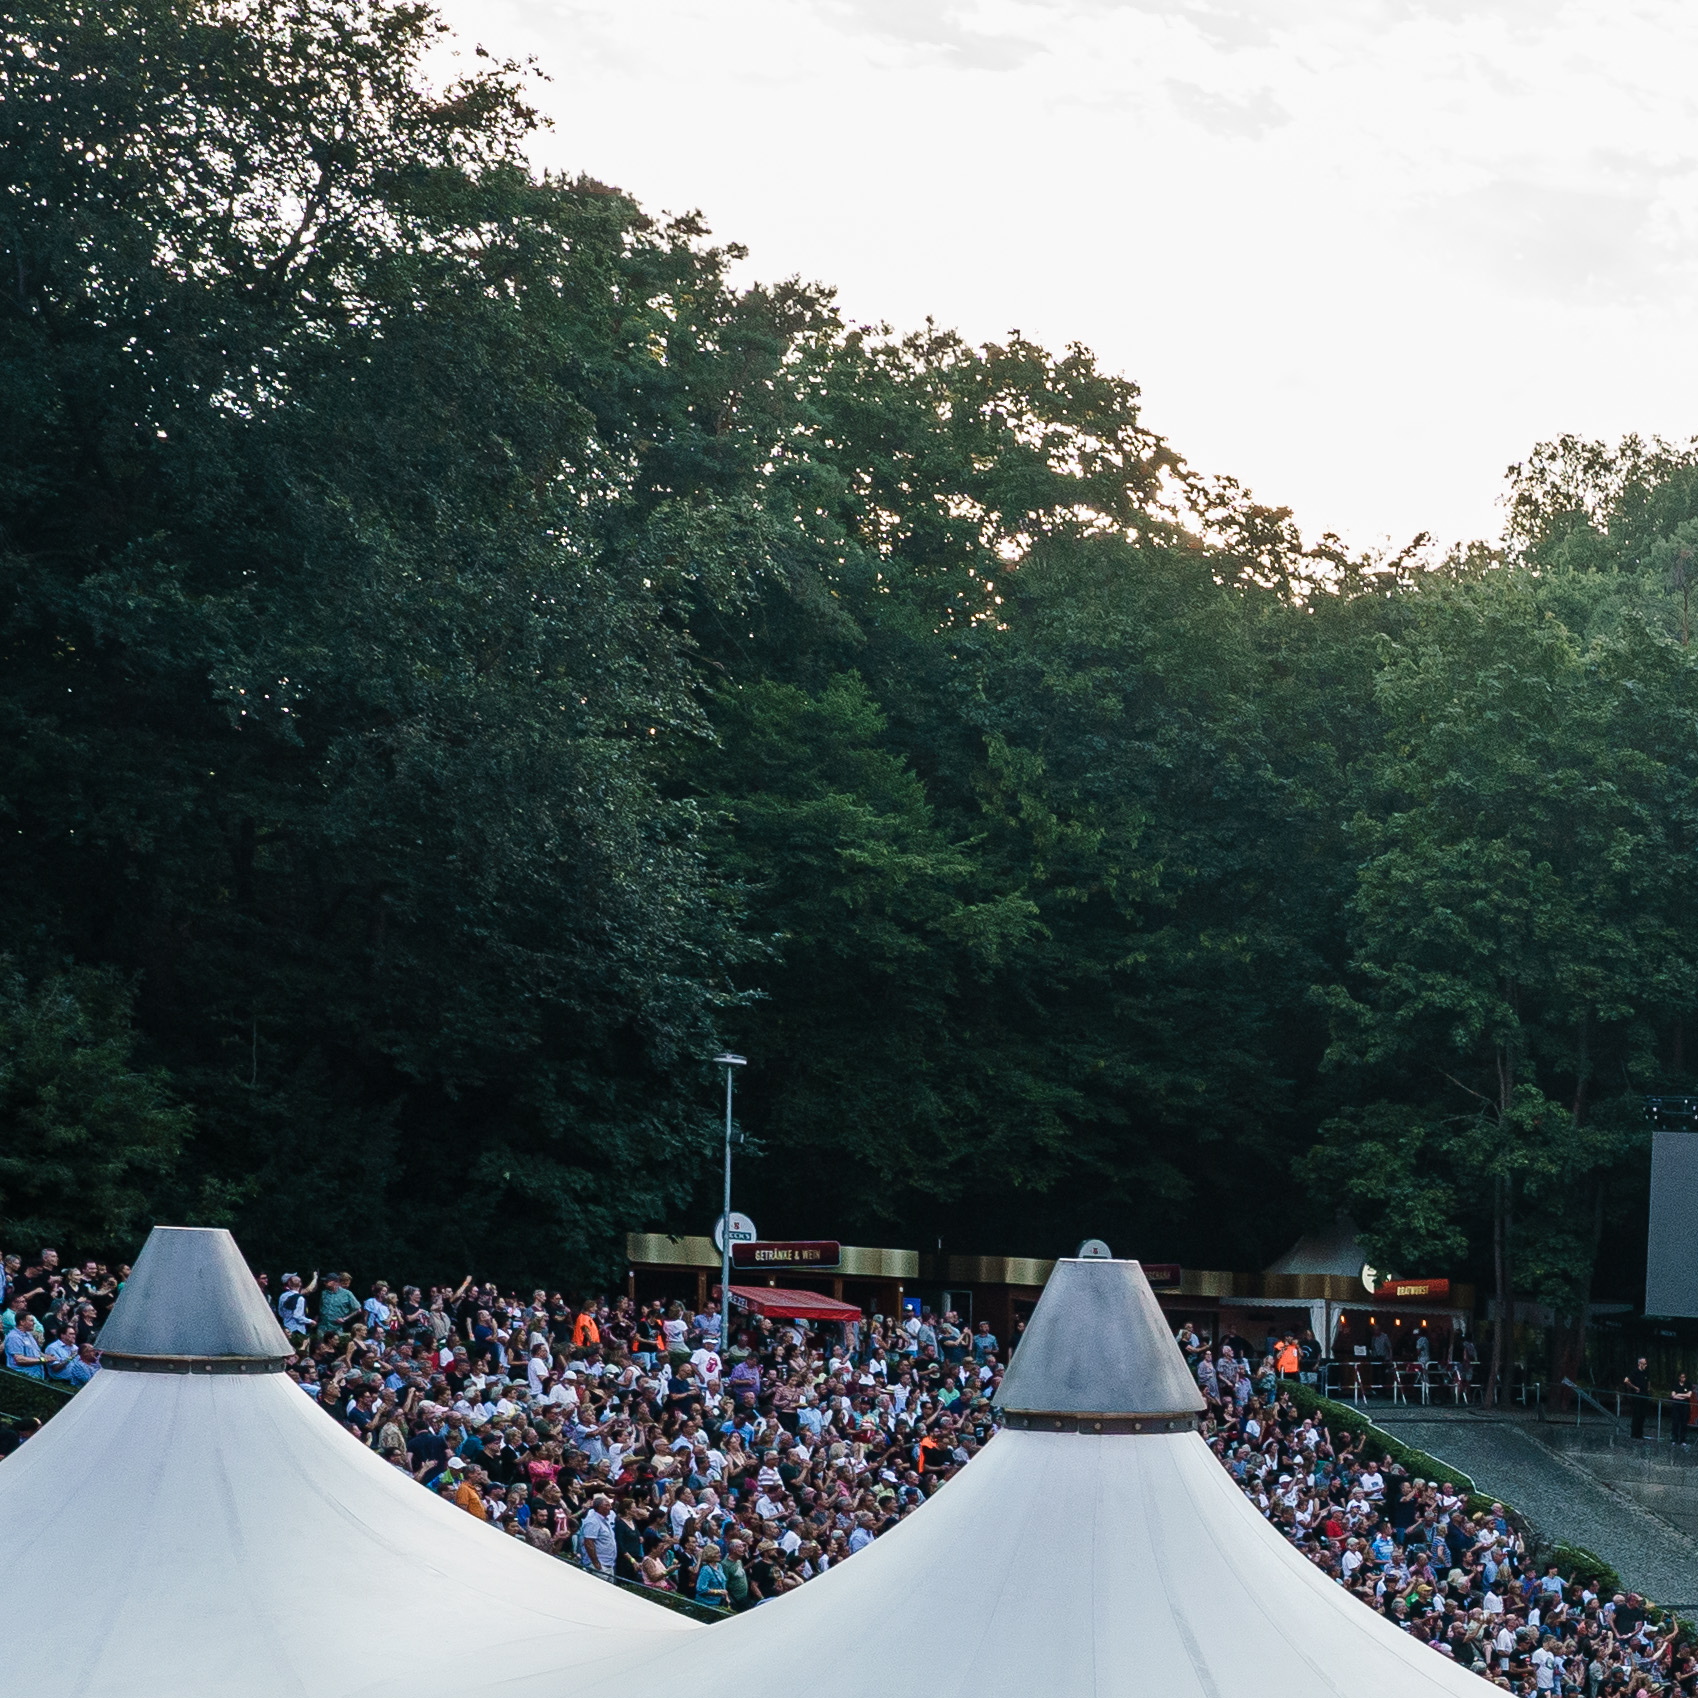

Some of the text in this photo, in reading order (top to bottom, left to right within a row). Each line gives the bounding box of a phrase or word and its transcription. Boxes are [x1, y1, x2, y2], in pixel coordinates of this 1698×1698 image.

[755, 1248, 820, 1260] GETRÄNKE & WEIN
